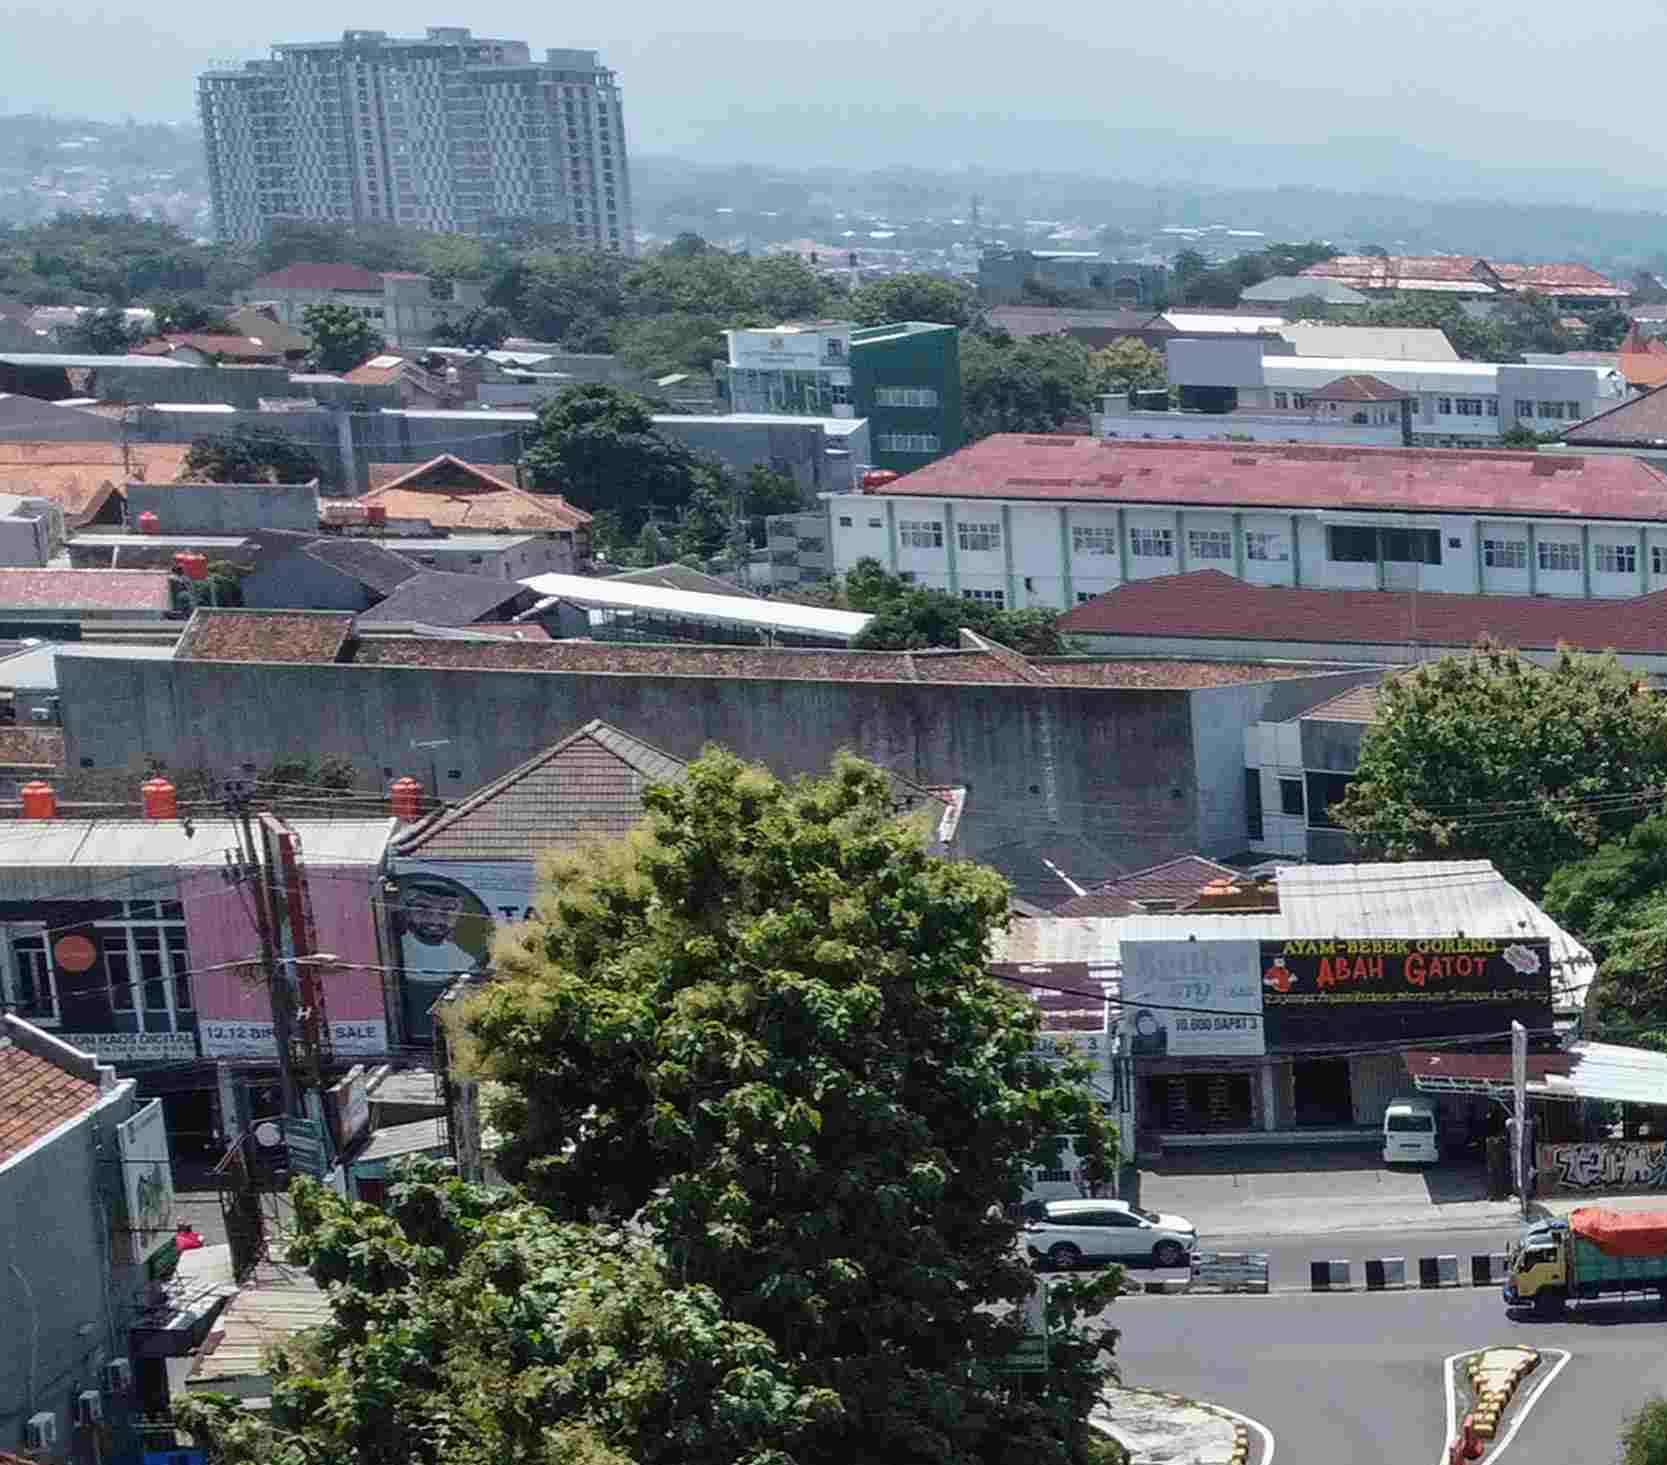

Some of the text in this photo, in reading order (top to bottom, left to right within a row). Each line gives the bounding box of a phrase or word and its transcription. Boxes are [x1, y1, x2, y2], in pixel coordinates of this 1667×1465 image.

[1283, 938, 1496, 955] AYAM-BEBEK GORENG
[1316, 953, 1488, 989] ABAH GATOT
[335, 1027, 377, 1039] SALE
